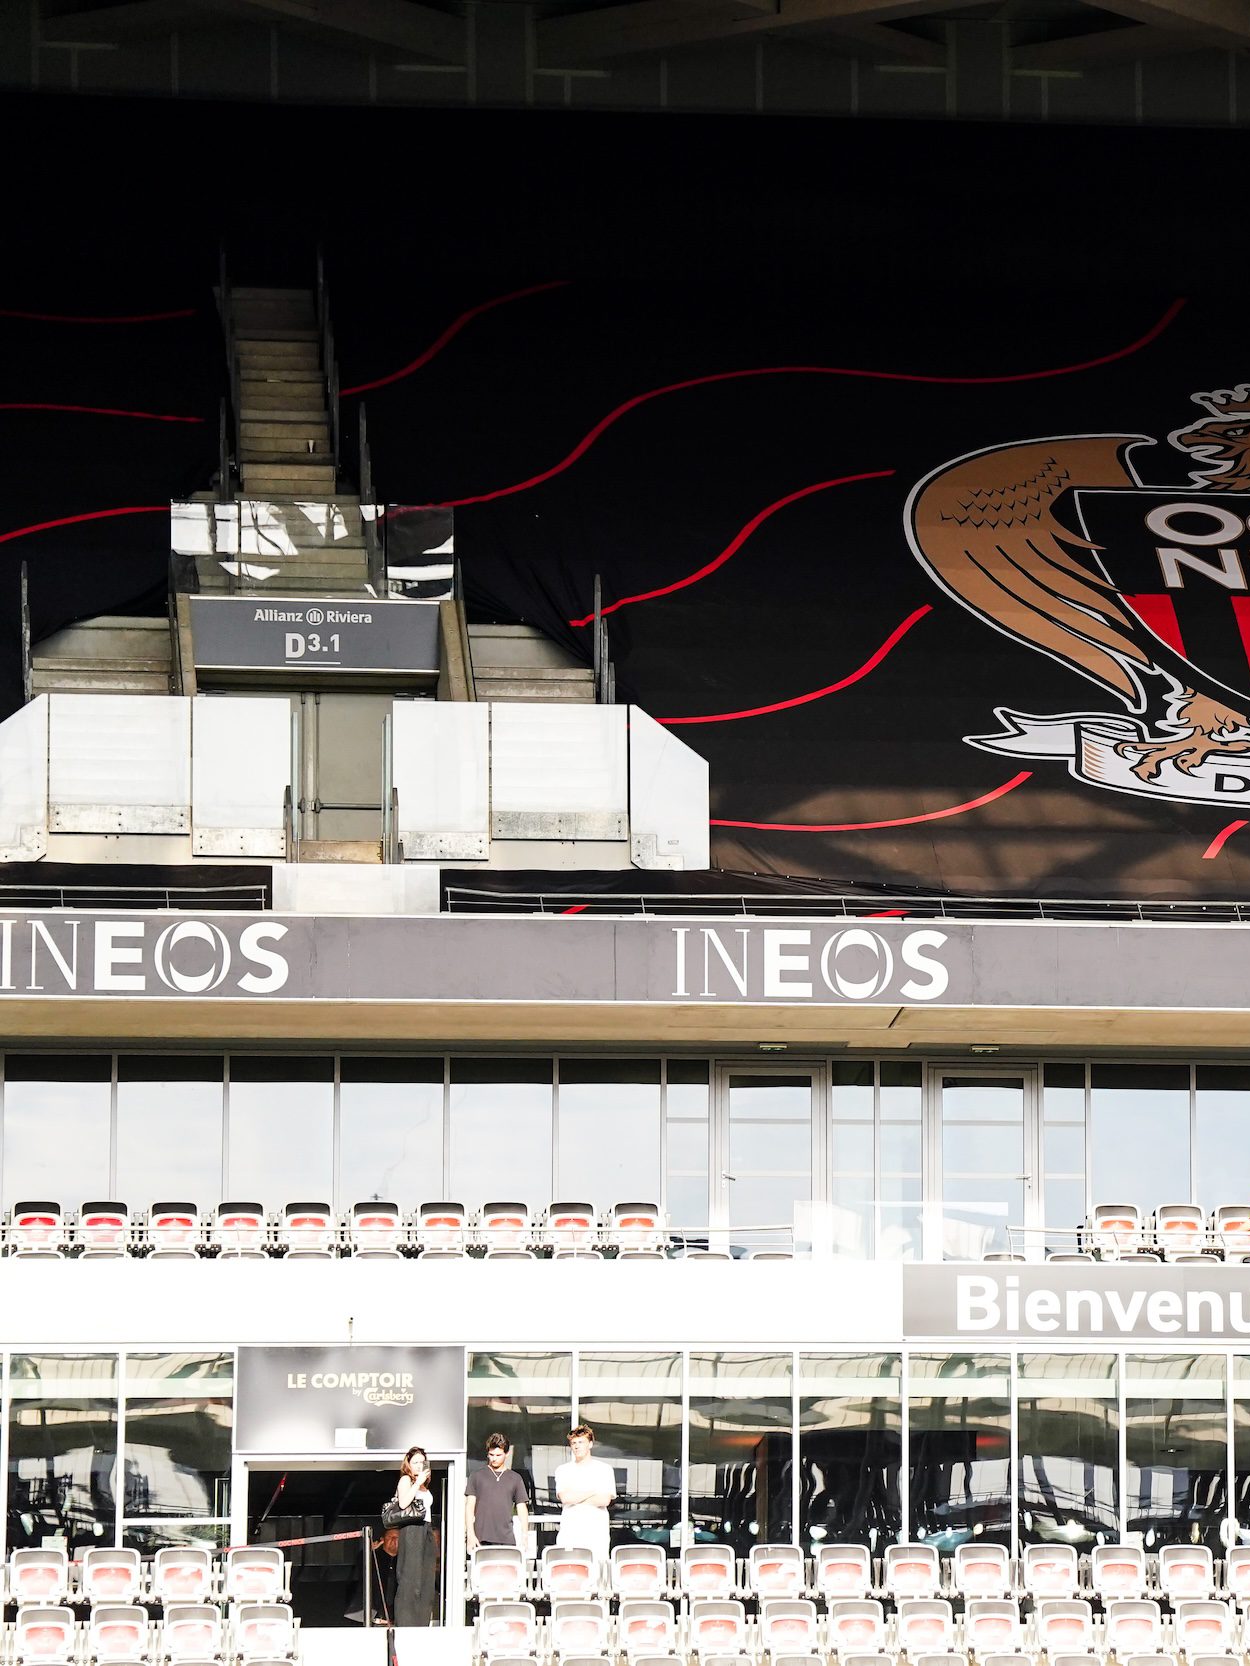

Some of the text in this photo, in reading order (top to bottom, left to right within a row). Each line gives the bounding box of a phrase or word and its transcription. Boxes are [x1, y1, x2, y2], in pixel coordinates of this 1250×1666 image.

[254, 609, 372, 623] Allianz Riviera
[0, 919, 289, 994] INEOS
[671, 928, 949, 1000] INEOS
[287, 1372, 414, 1389] LE COMPTOIR
[352, 1387, 414, 1407] by Carlsberg
